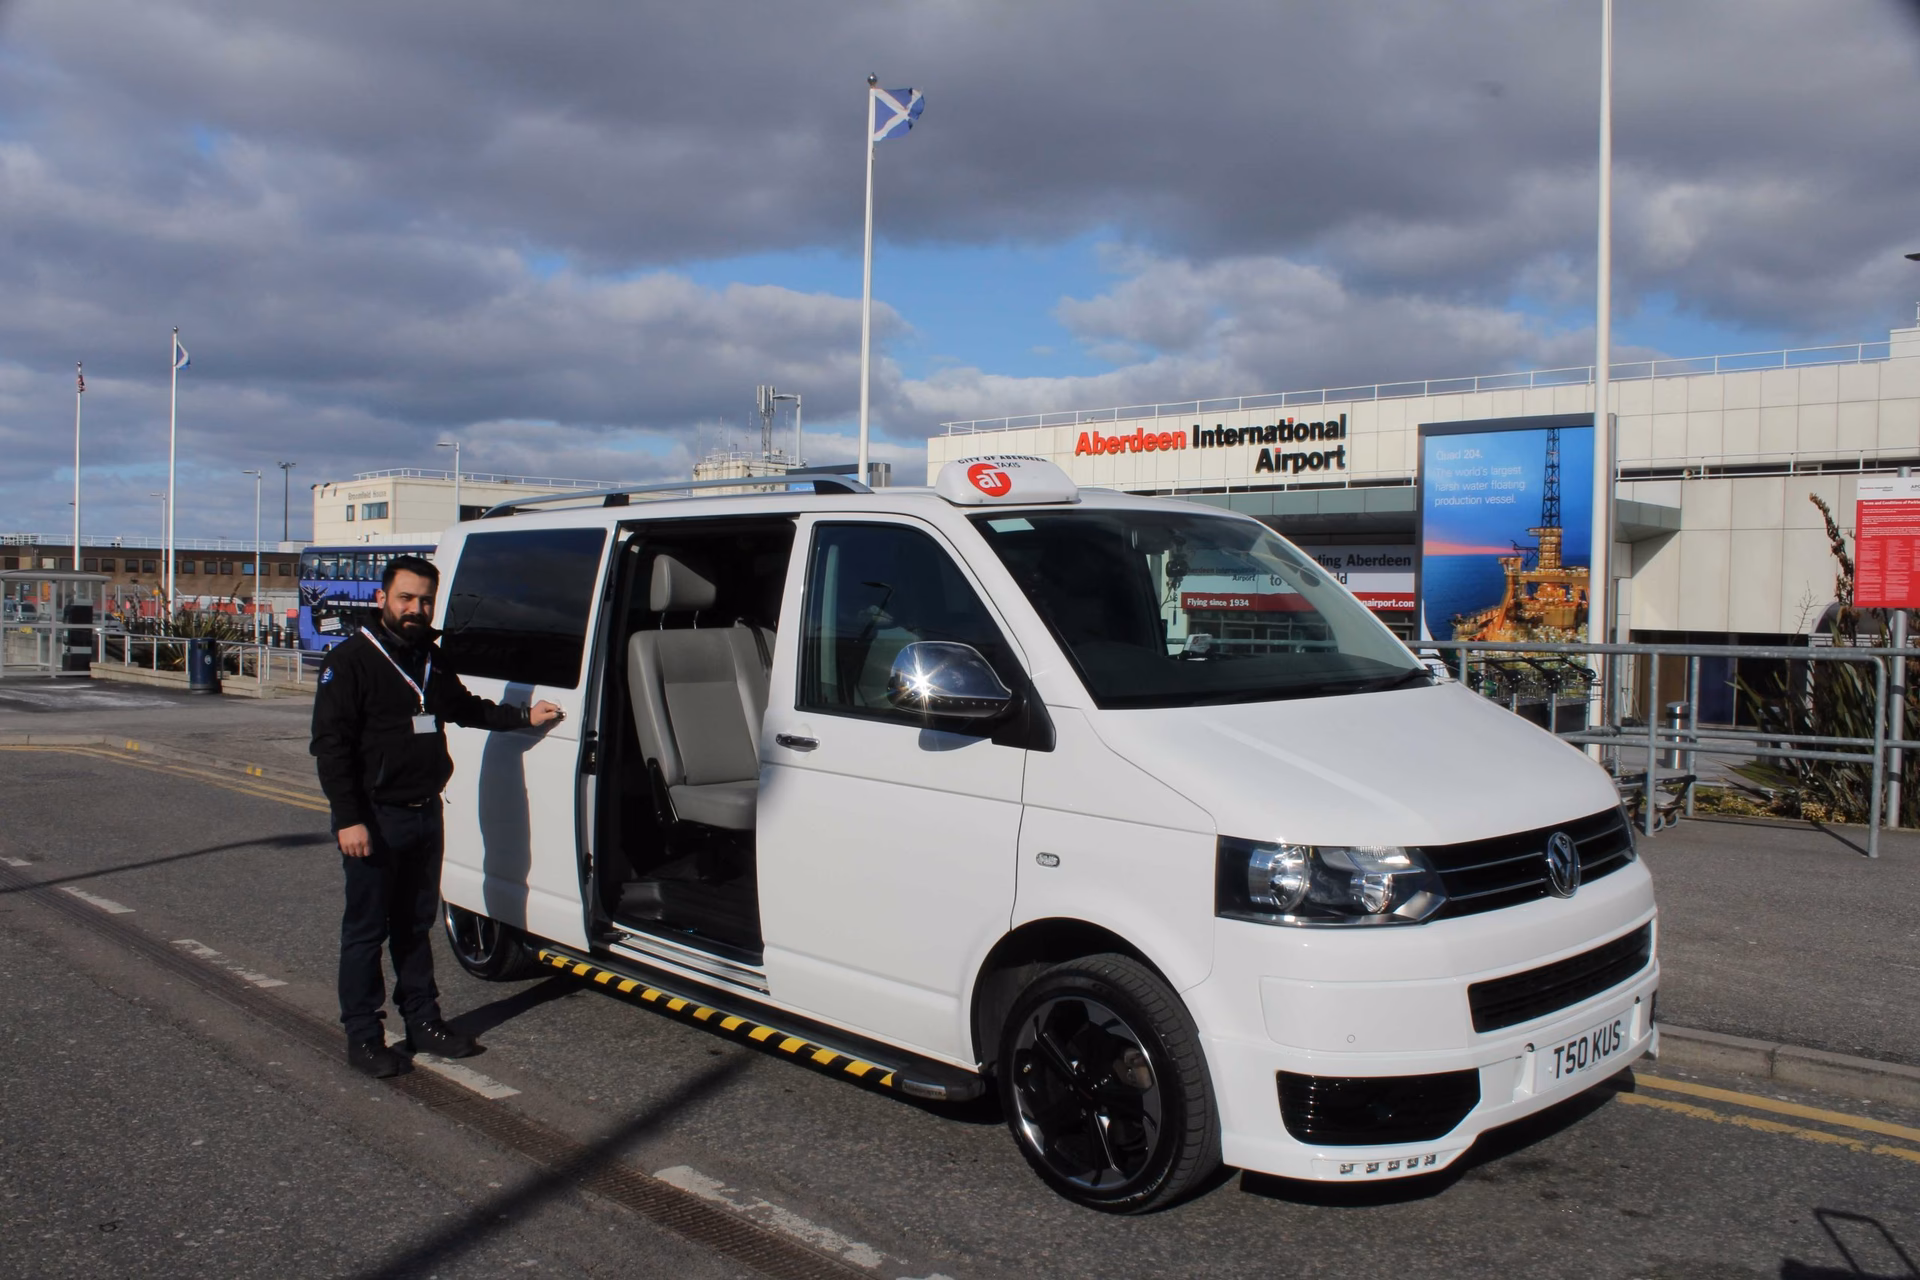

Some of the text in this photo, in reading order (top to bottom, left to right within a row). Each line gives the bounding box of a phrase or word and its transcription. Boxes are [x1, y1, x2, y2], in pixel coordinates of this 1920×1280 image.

[1075, 413, 1347, 456] Aberdeen International
[1255, 444, 1346, 474] Airport
[1436, 449, 1483, 460] Quad 204.
[1435, 465, 1522, 477] The world's largest
[1435, 479, 1526, 492] harsh water floating
[1434, 493, 1517, 508] production vessel.
[1346, 553, 1412, 567] Aberdeen
[1232, 574, 1256, 582] Airport
[1269, 574, 1282, 587] to
[1187, 598, 1249, 607] Flying since 1934
[1553, 1019, 1622, 1079] T50 KUS
